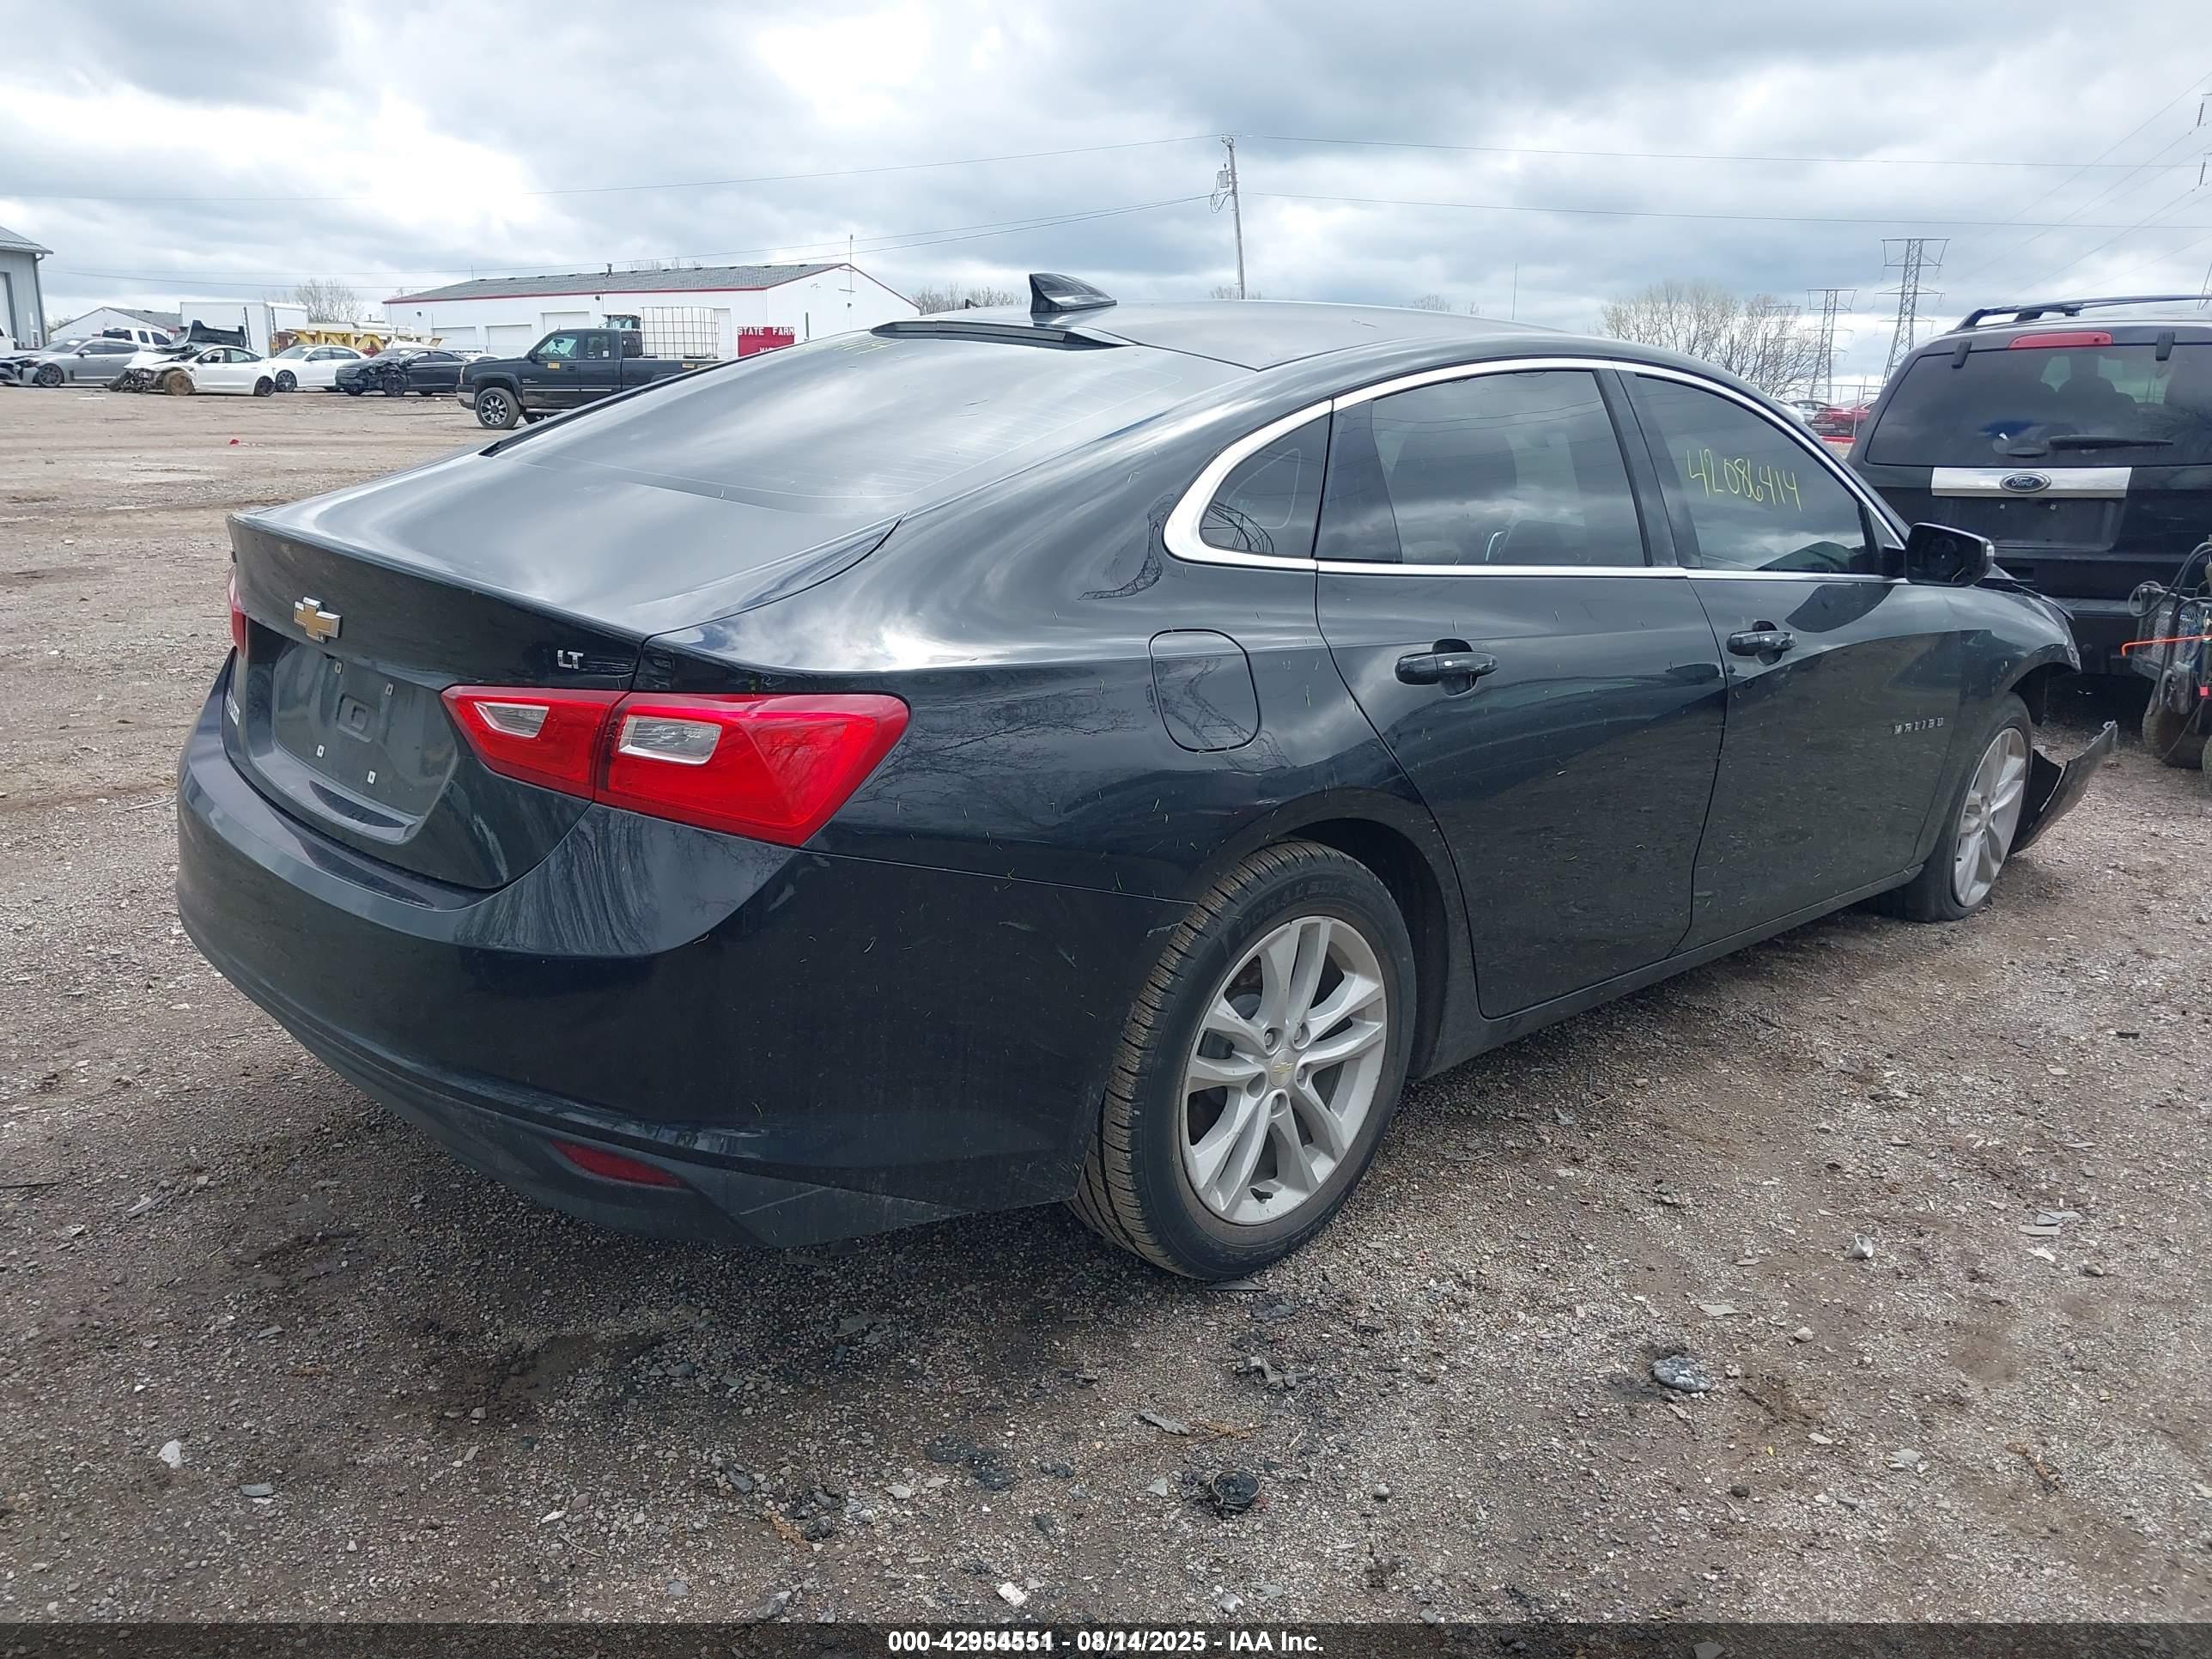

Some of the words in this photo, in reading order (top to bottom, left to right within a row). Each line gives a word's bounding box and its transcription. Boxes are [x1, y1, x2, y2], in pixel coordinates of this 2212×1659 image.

[738, 327, 765, 336] STATE
[772, 327, 795, 336] FARM
[1686, 447, 1802, 513] 42086414
[557, 649, 585, 670] LT
[1892, 716, 1945, 736] MALIBU
